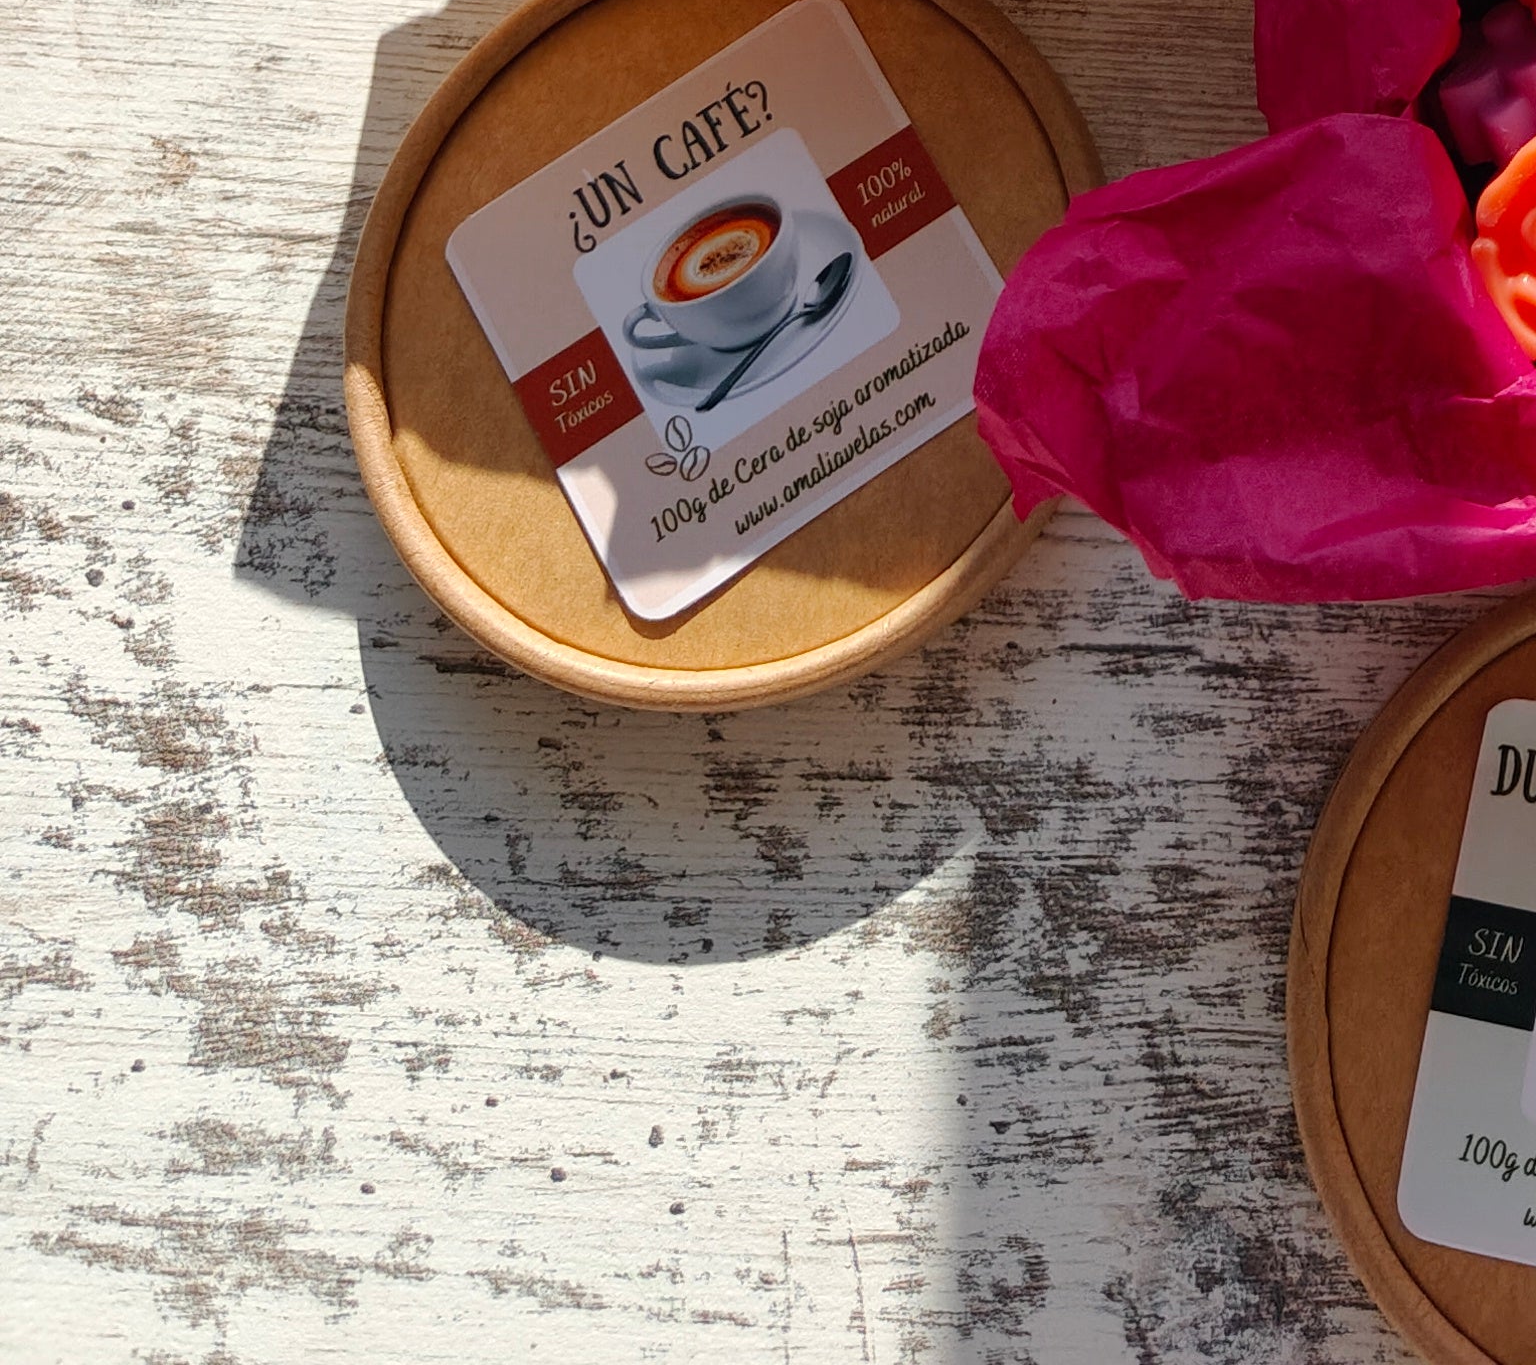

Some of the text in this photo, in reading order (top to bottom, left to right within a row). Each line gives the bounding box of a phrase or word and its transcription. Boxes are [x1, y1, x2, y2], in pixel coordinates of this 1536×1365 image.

[569, 78, 775, 254] ¿UN CAFÉ?
[856, 157, 913, 207] 100%
[870, 185, 926, 230] natural
[549, 359, 597, 408] SIN
[553, 388, 614, 436] Tóxicos
[651, 321, 970, 543] 100g de Cera de soja aromatizada
[735, 391, 936, 535] www.amaliavelas.com
[1467, 928, 1525, 964] SIN
[1456, 962, 1519, 997] Tóxicos
[1458, 1132, 1521, 1182] 100g
